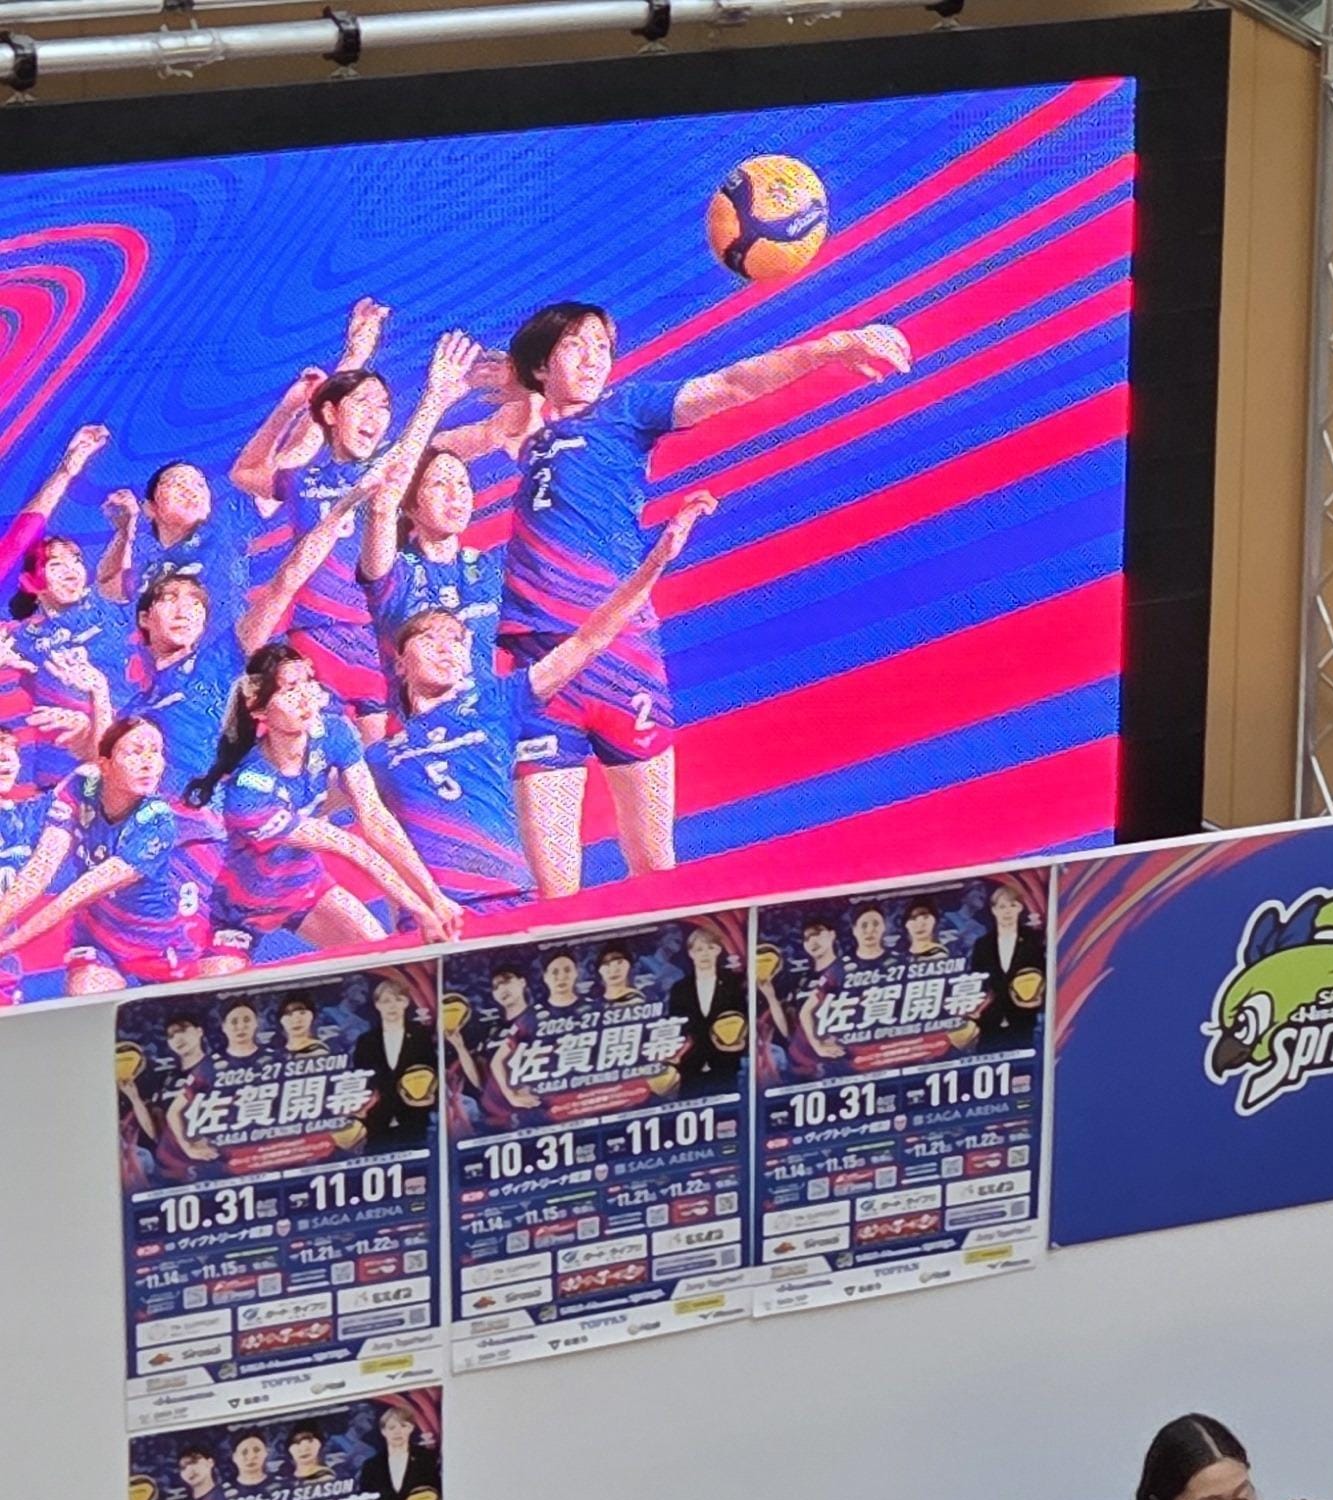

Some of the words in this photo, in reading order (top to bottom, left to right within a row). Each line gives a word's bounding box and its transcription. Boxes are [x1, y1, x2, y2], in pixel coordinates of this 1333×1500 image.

[630, 691, 656, 731] 2
[425, 759, 463, 801] 5
[844, 966, 905, 988] 2026-27
[908, 958, 965, 979] SEASON
[536, 1012, 600, 1036] 2026-27
[603, 1002, 663, 1025] SEASON
[816, 972, 989, 1035] 佐賀開幕
[214, 1063, 281, 1087] 2026-27
[285, 1055, 348, 1077] SEASON
[509, 1017, 689, 1085] 佐賀開幕
[186, 1070, 375, 1137] 佐賀開幕
[791, 1083, 877, 1128] 10.31
[926, 1062, 1011, 1107] 11.01
[626, 1108, 715, 1155] 11.01
[485, 1132, 575, 1180] 10.31
[160, 1186, 255, 1233] 10.31
[310, 1164, 403, 1211] 11.01
